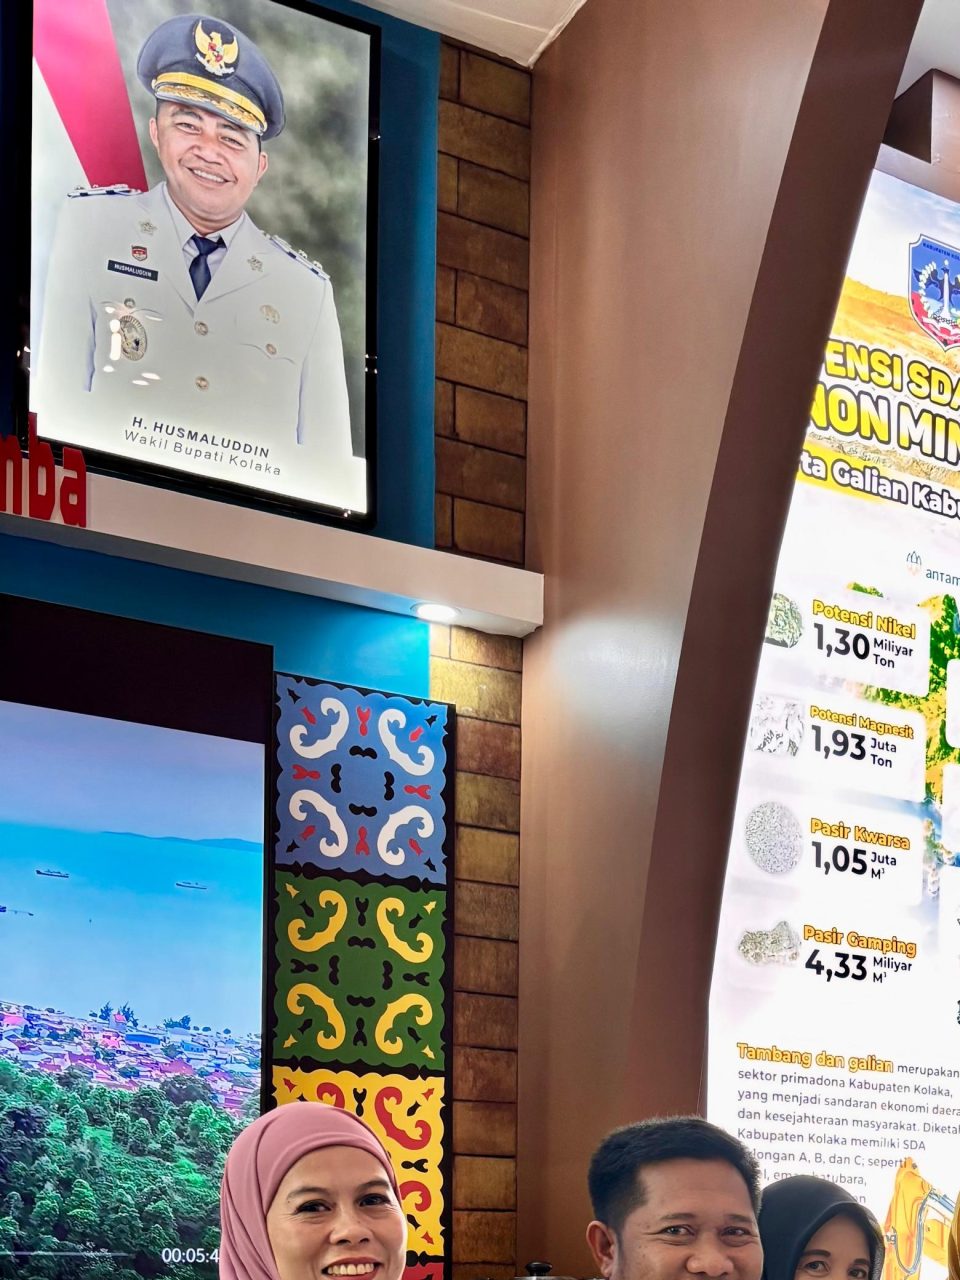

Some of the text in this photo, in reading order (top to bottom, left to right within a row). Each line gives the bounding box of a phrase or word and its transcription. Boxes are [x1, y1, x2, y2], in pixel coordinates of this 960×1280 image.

[114, 263, 152, 277] HUSMALUDDIN
[124, 429, 281, 477] Wakil Bupati Kolaka
[132, 416, 270, 459] H. HUSMALUDDIN
[831, 461, 908, 504] Galian
[812, 599, 916, 640] Potensi Nikel
[813, 622, 914, 660] 1,30 Miliyar
[873, 653, 895, 669] Ton
[810, 705, 914, 740] Potensi Magnesit
[811, 724, 897, 761] 1,93 Juta
[870, 753, 893, 769] Ton
[810, 817, 911, 850] Pasir Kwarsa
[811, 840, 897, 876] 1,05 Juta
[803, 924, 917, 959] Pasir Gamping
[805, 949, 912, 983] 4,33 Miliyar
[736, 1042, 960, 1080] Tambang dan galian merupakan
[737, 1068, 953, 1099] sektor primadona Kabupaten Kolaka,
[737, 1088, 768, 1104] yang
[772, 1092, 821, 1107] menjadi
[824, 1096, 877, 1110] sandaran
[880, 1100, 929, 1114] ekonomi
[737, 1108, 761, 1121] dan
[765, 1111, 848, 1127] kesejahteraan
[852, 1117, 920, 1133] masyarakat.
[737, 1128, 926, 1151] Kabupaten Kolaka memiliki SDA
[753, 1148, 795, 1164] longan
[829, 1154, 850, 1165] dan
[868, 1157, 907, 1170] seperti
